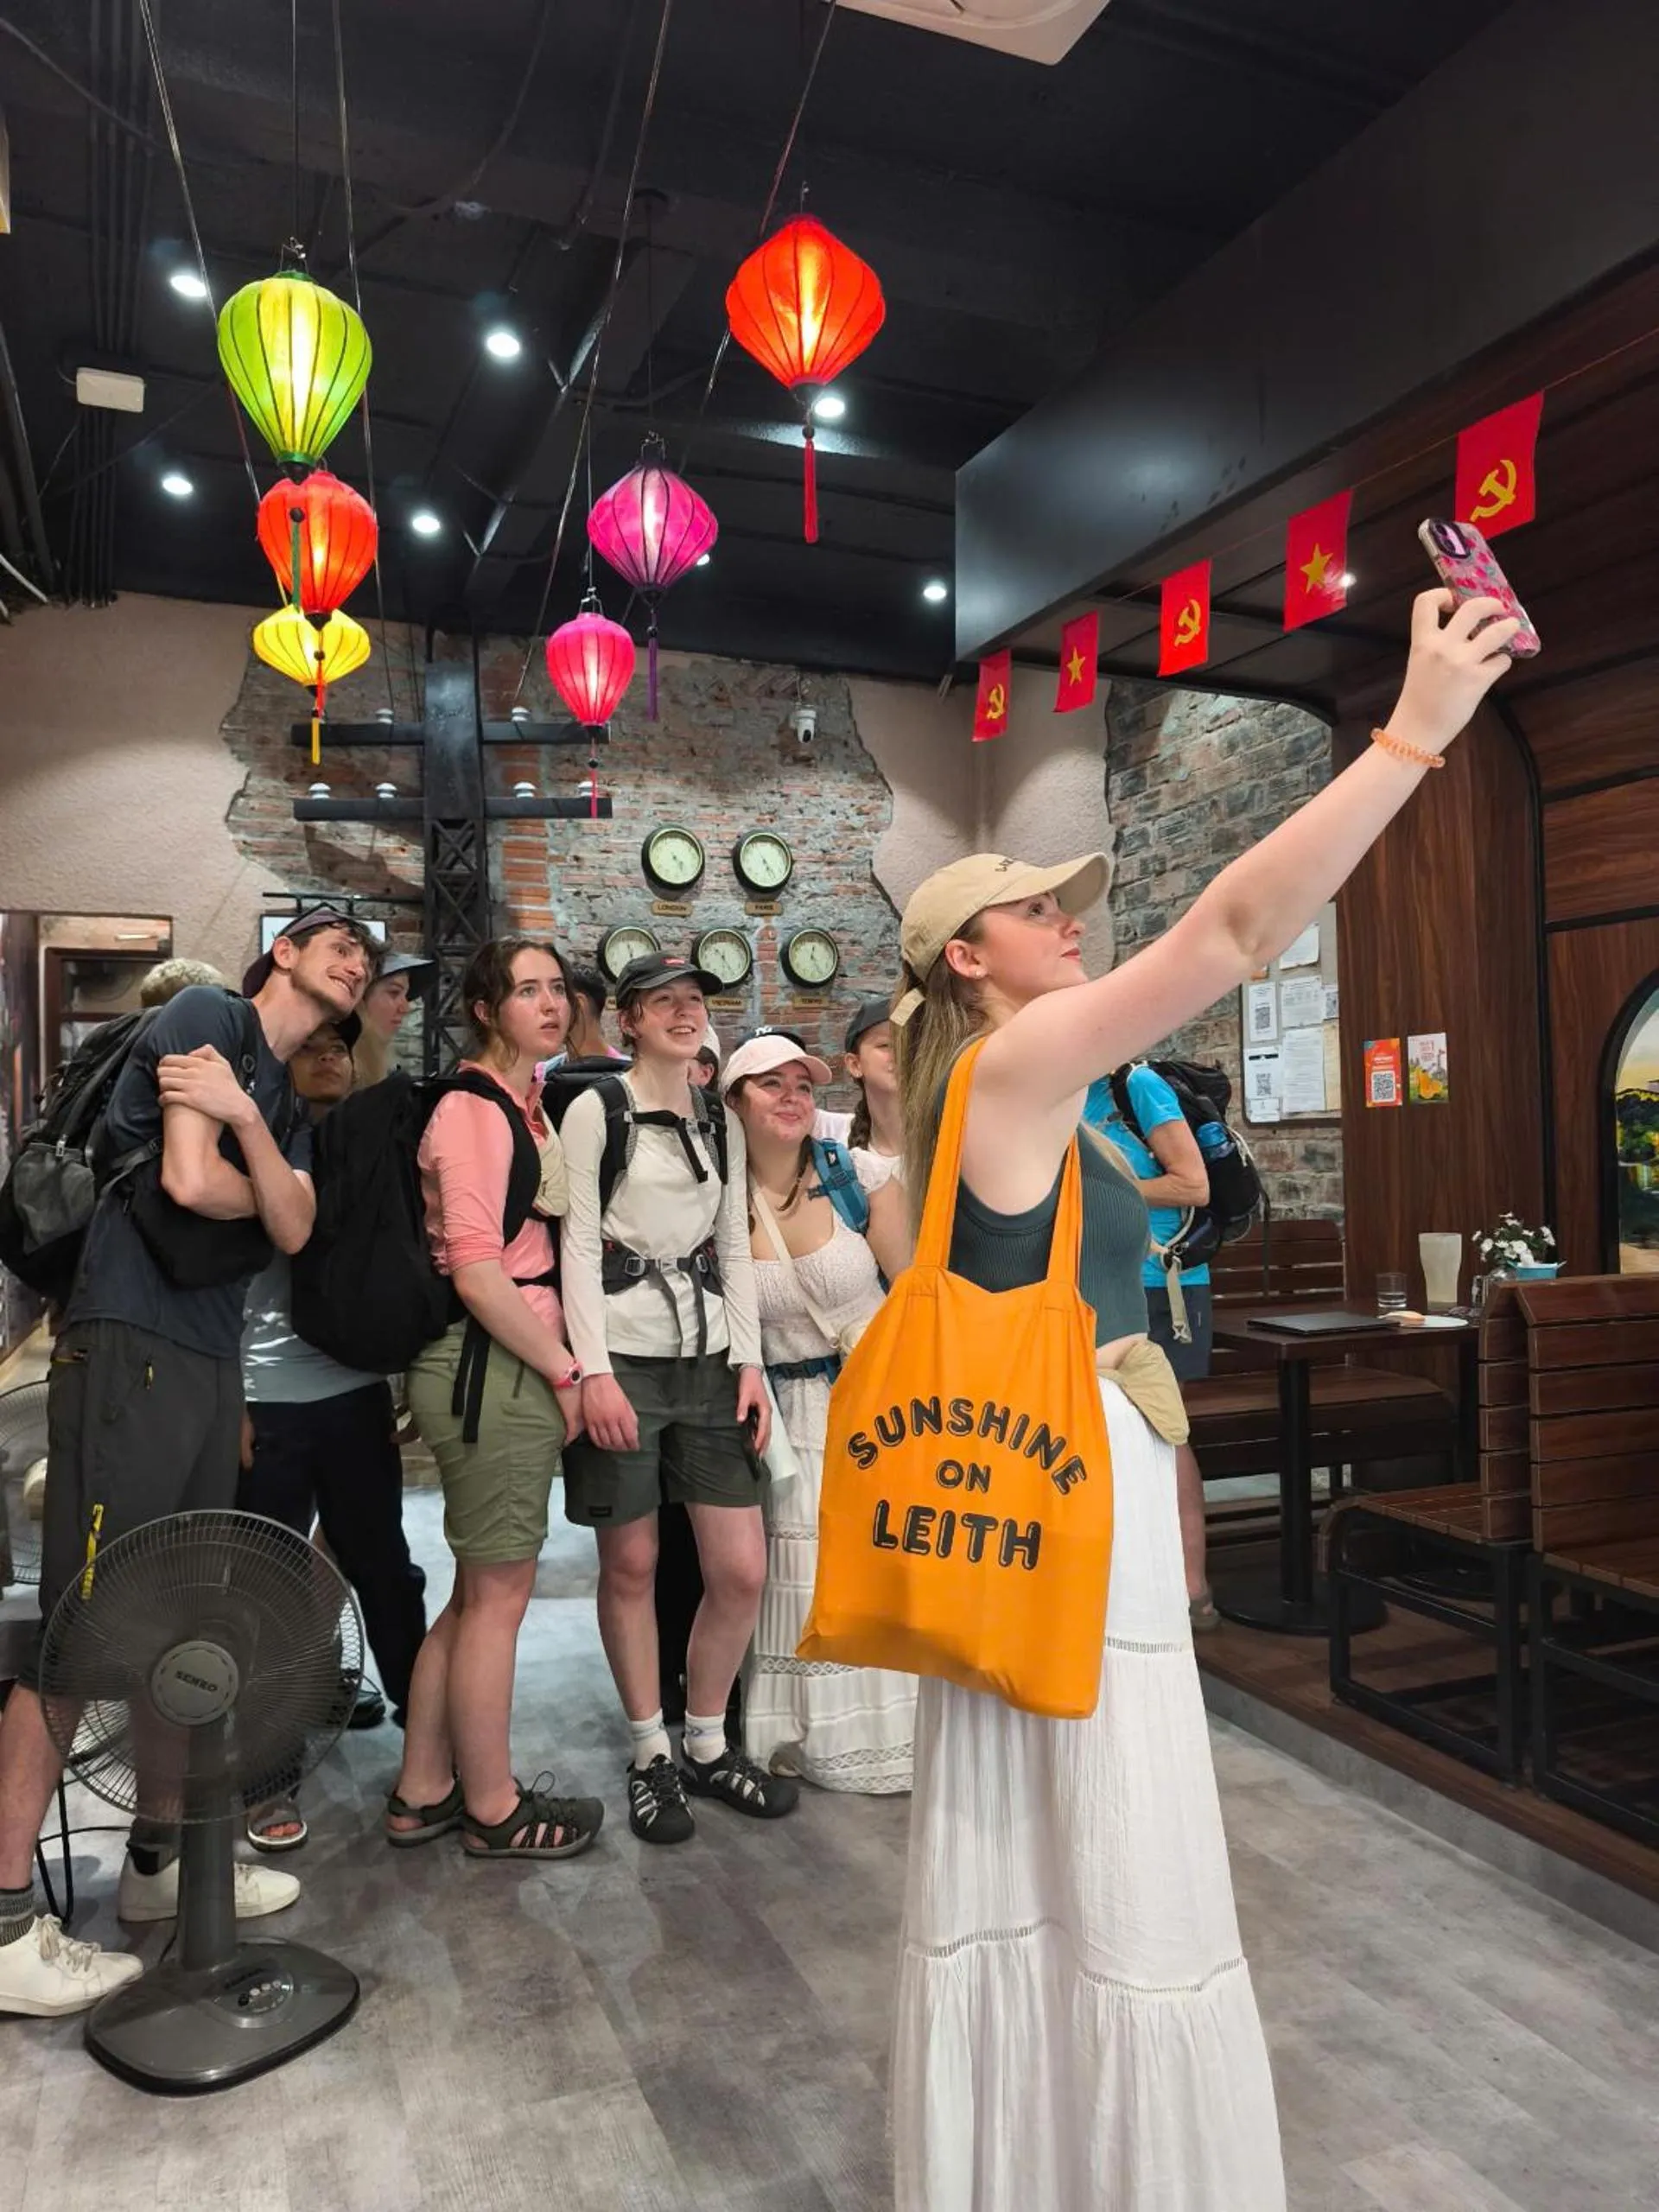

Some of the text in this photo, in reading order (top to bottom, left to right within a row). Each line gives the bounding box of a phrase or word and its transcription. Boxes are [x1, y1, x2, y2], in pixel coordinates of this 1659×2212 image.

[657, 902, 687, 912] LONDON
[847, 1395, 1087, 1495] SUNSHINE
[936, 1459, 991, 1493] ON
[873, 1499, 1041, 1570] LEITH
